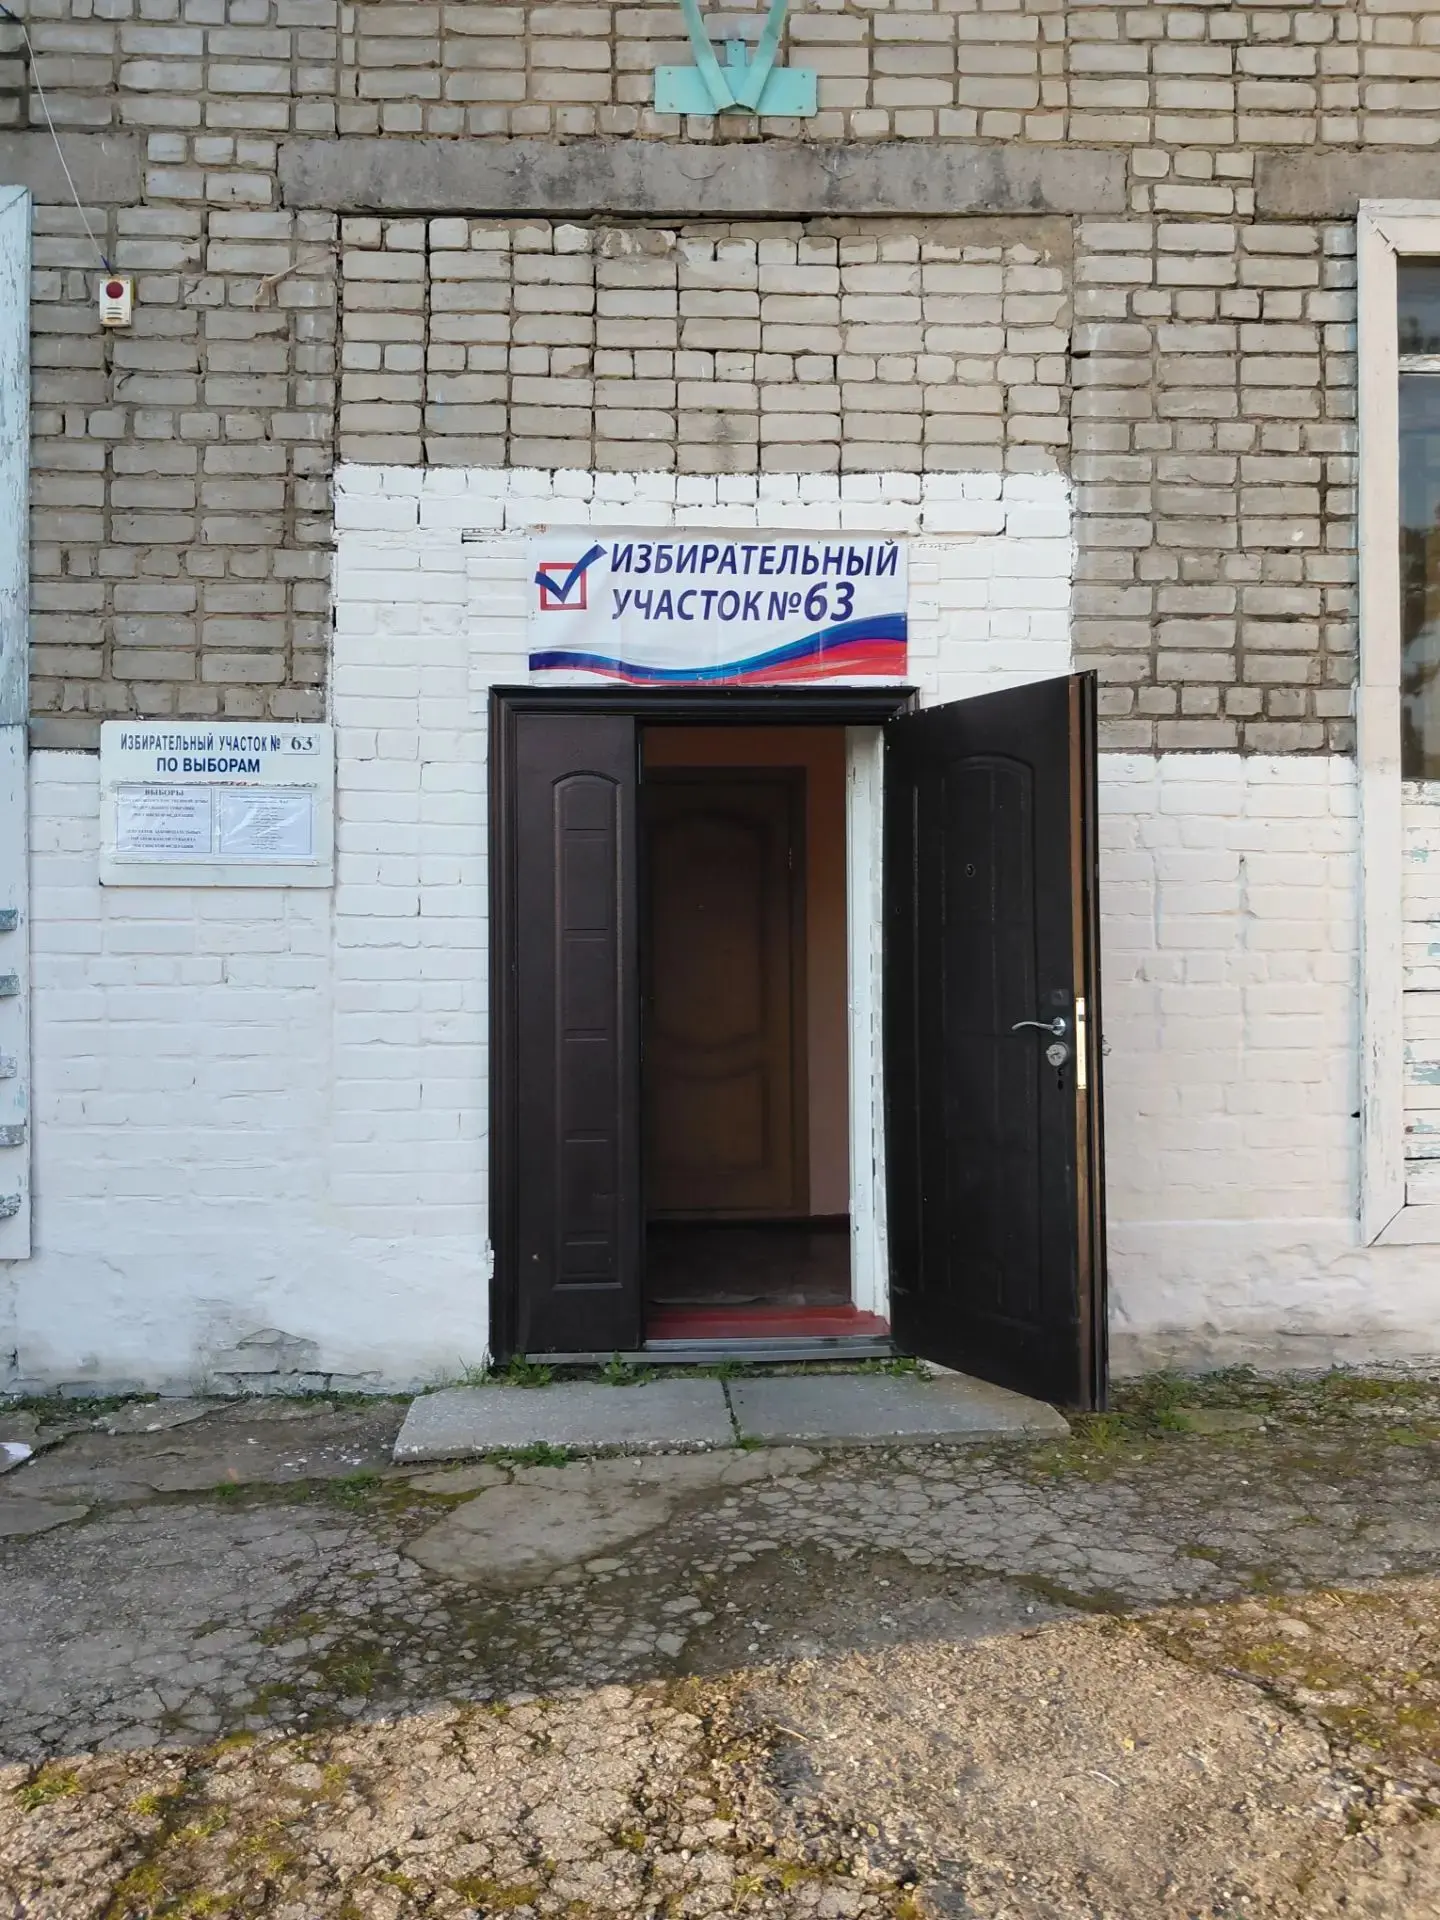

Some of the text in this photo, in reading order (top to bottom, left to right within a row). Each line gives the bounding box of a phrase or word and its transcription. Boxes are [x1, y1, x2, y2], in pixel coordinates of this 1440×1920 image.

[610, 539, 899, 576] ИЗБИРАТЕЛЬНЫЙ
[611, 588, 764, 621] УЧАСТОК
[120, 732, 214, 751] ИЗБИРАТЕЛЬНЫЙ
[219, 733, 267, 752] УЧАСТОК
[290, 736, 313, 750] 63
[156, 757, 260, 773] ПО ВЫБОРАМ
